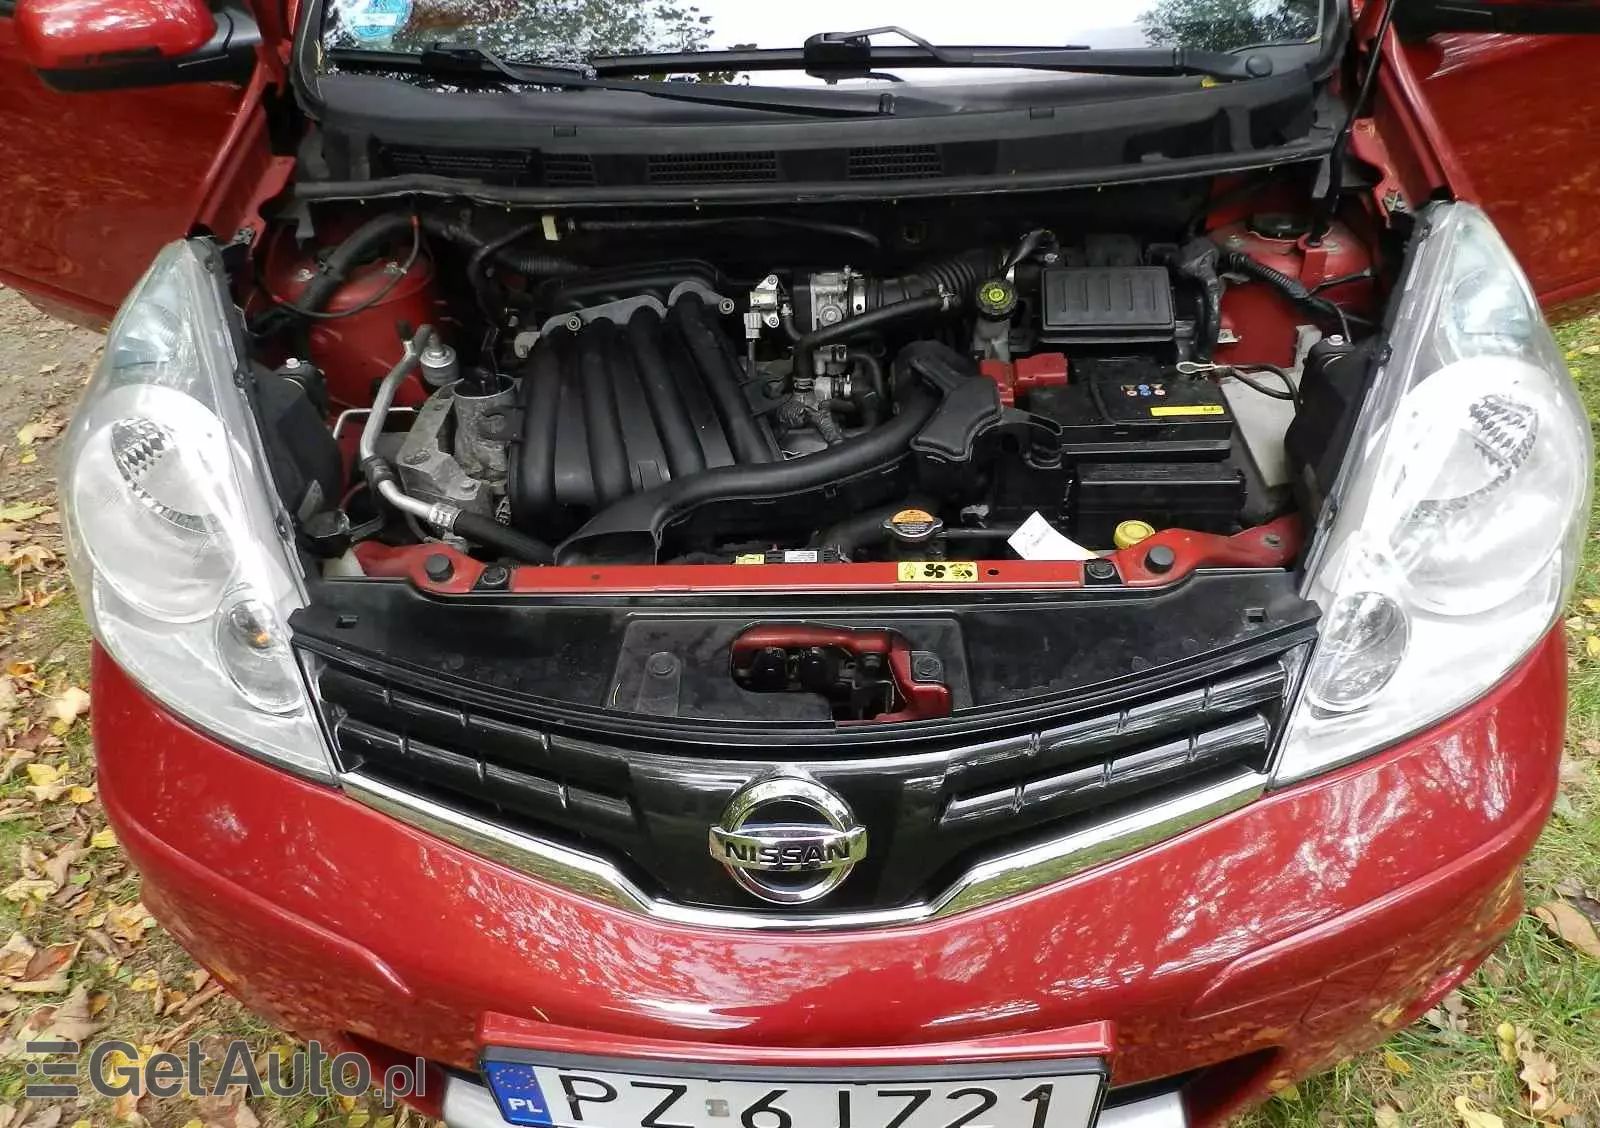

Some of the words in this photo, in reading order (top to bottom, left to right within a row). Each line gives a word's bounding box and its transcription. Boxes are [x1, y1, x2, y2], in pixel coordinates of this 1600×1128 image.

[725, 841, 850, 866] NISSAN
[507, 1097, 544, 1114] PL
[558, 1074, 696, 1128] PZ
